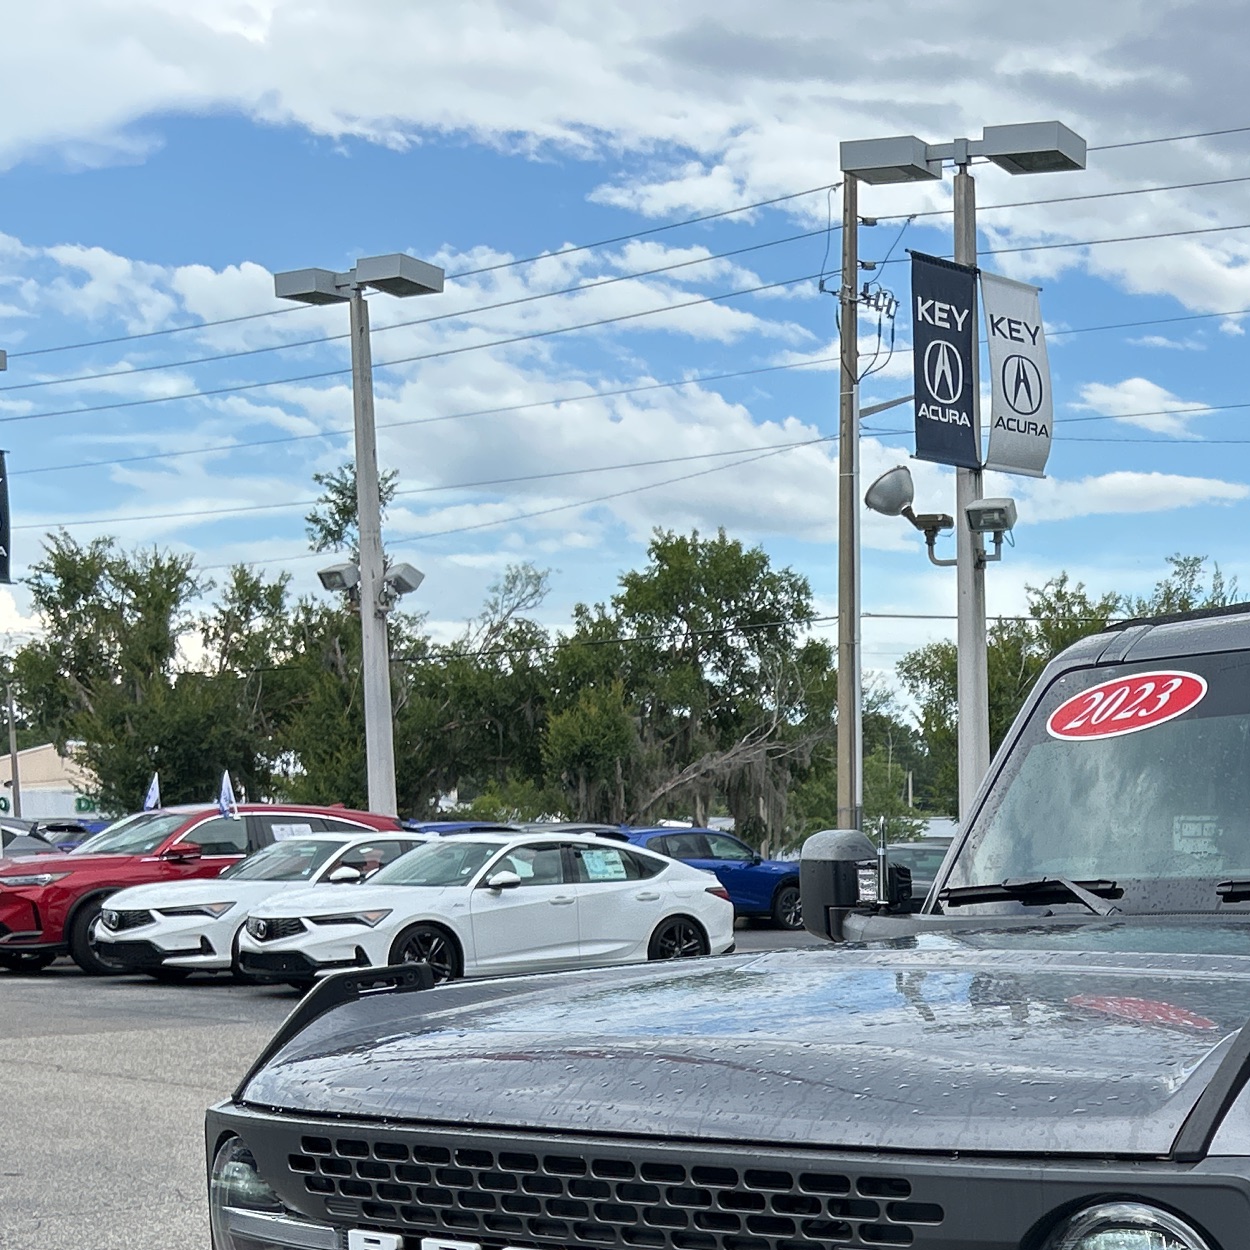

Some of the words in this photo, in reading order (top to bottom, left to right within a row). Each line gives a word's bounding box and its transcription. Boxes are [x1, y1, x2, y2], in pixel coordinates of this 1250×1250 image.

[917, 296, 969, 332] KEY
[989, 313, 1040, 346] KEY
[918, 403, 971, 428] ACURA
[994, 416, 1049, 438] ACURA
[1062, 678, 1183, 731] 2023
